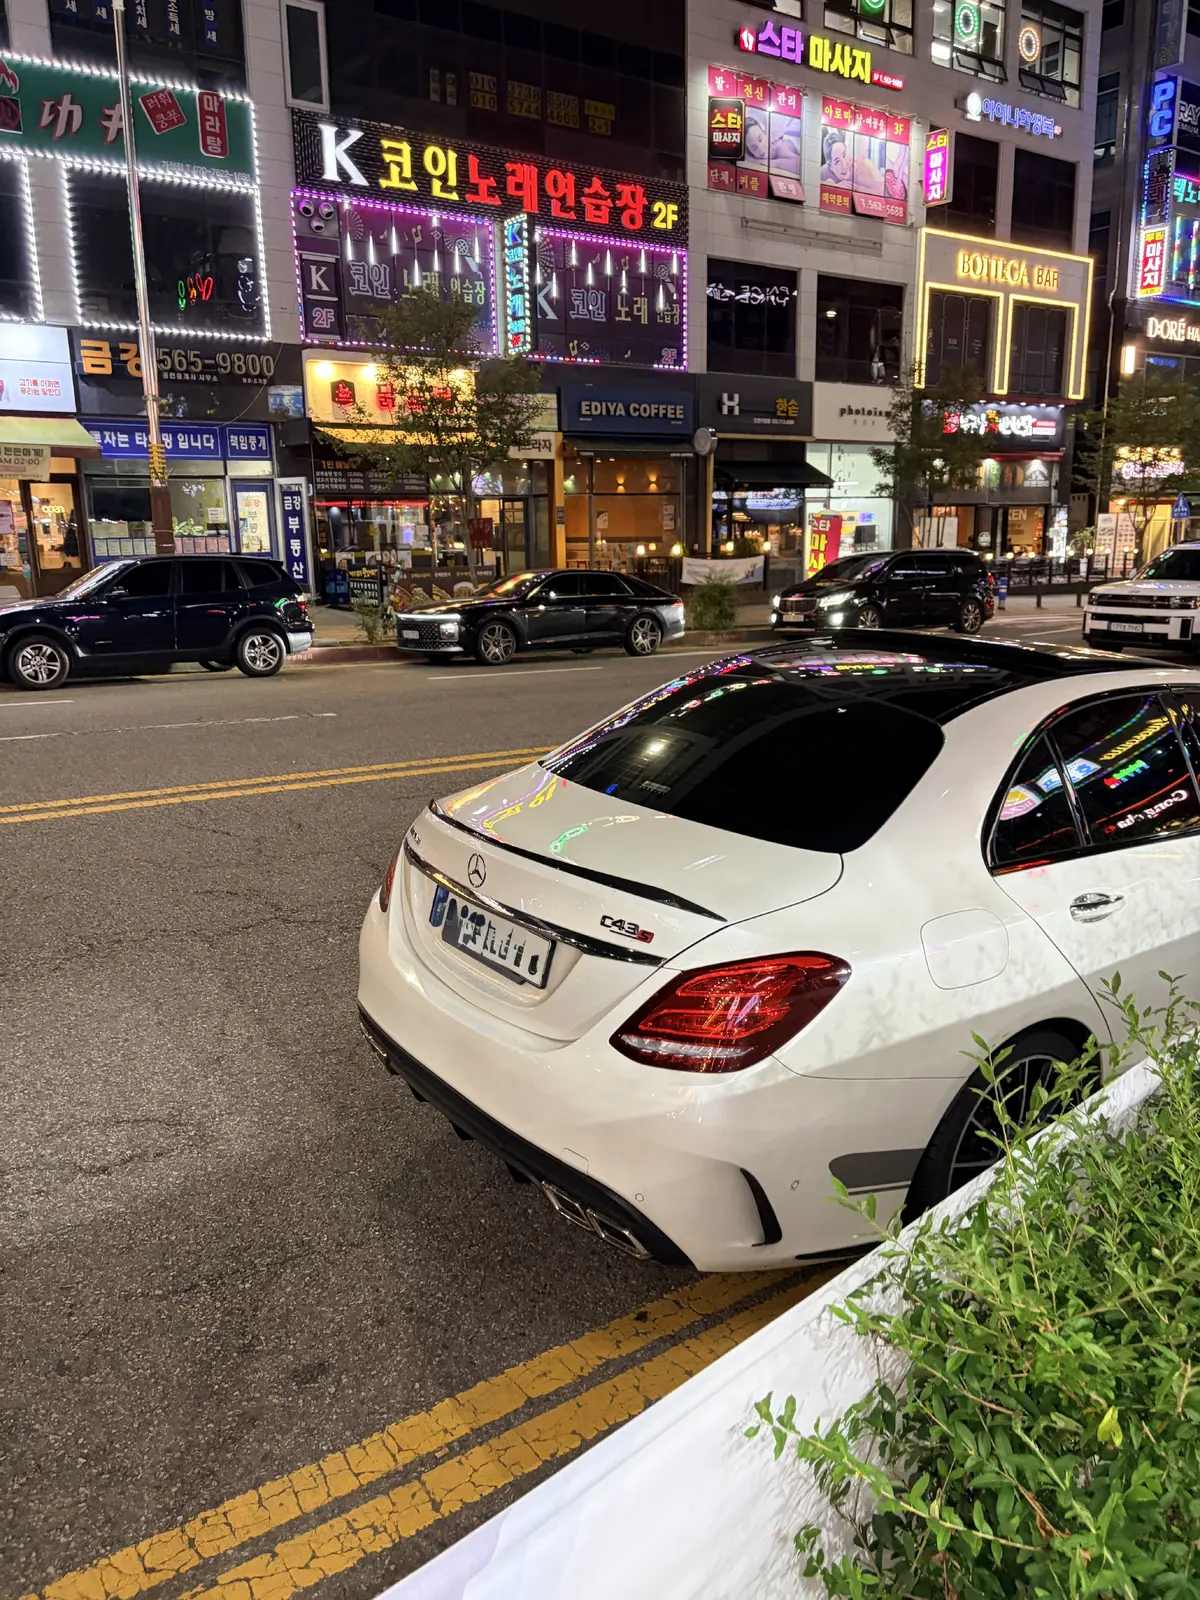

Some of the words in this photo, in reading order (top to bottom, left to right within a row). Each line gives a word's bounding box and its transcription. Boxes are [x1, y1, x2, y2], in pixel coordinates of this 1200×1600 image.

[757, 20, 804, 64] 스타
[809, 35, 871, 85] 마사지
[471, 91, 497, 110] 010
[777, 92, 796, 109] 관리
[203, 94, 223, 154] 마라탕
[711, 112, 742, 129] 스타
[824, 104, 853, 124] 아로마
[893, 122, 904, 136] 3F
[982, 98, 1054, 139] 아이니학생복
[712, 132, 741, 143] 마사지
[926, 134, 948, 152] 스타
[317, 124, 370, 186] K
[653, 201, 679, 230] 2F
[928, 151, 943, 201] 마사지
[961, 252, 1030, 286] BOTTEGA
[1036, 267, 1061, 289] BAR
[1143, 241, 1162, 285] 마사지
[309, 265, 330, 291] K
[350, 261, 391, 299] 코인
[312, 307, 335, 328] 2F
[569, 289, 607, 322] 코인
[615, 295, 648, 324] 노래
[157, 346, 276, 377] 565-9800
[581, 401, 627, 417] EDIYA
[629, 403, 685, 419] COFFEE
[722, 393, 740, 416] H
[176, 432, 215, 450] 입니다
[41, 504, 65, 517] open
[283, 495, 301, 511] 금강
[288, 516, 304, 580] 부동산
